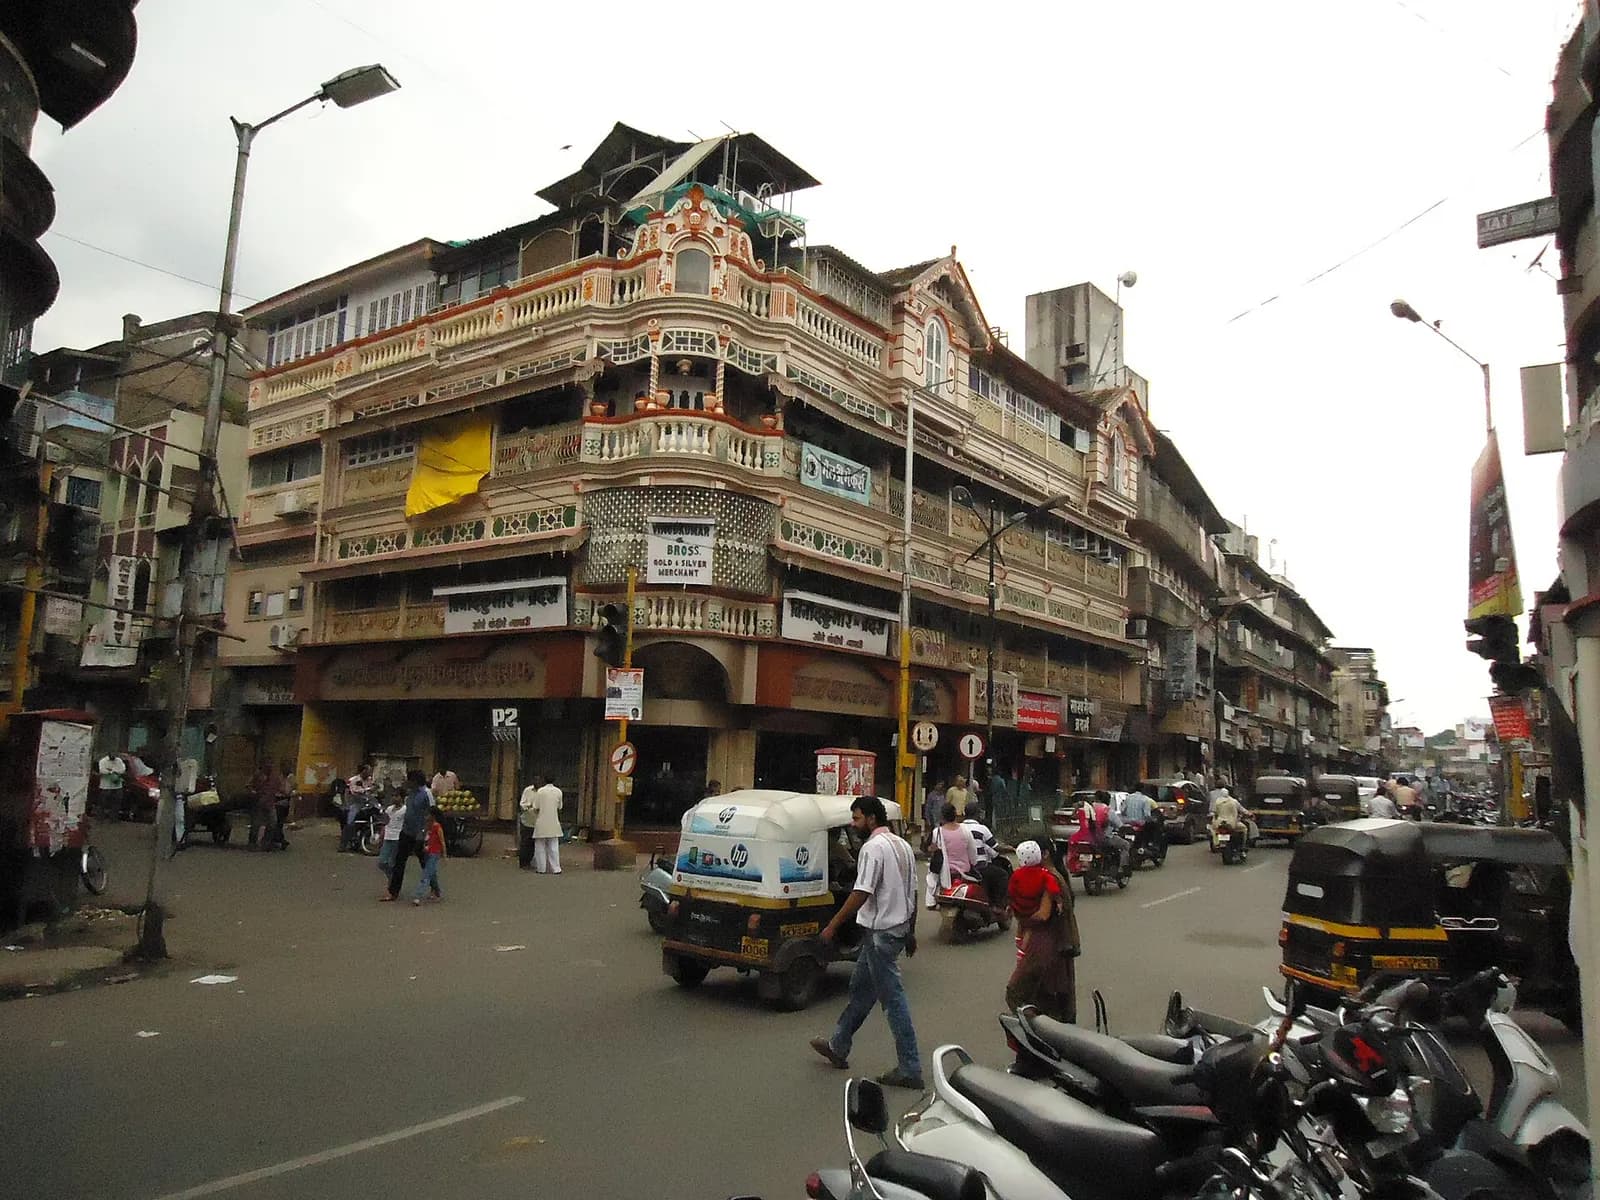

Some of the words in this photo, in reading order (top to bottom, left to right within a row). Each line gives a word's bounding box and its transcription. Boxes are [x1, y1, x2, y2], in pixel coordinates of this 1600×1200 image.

[654, 559, 673, 567] GOLD
[681, 559, 707, 568] SILVER
[658, 568, 699, 577] MERCHANT
[492, 708, 518, 727] P2
[731, 844, 747, 868] hp
[796, 847, 809, 866] hp
